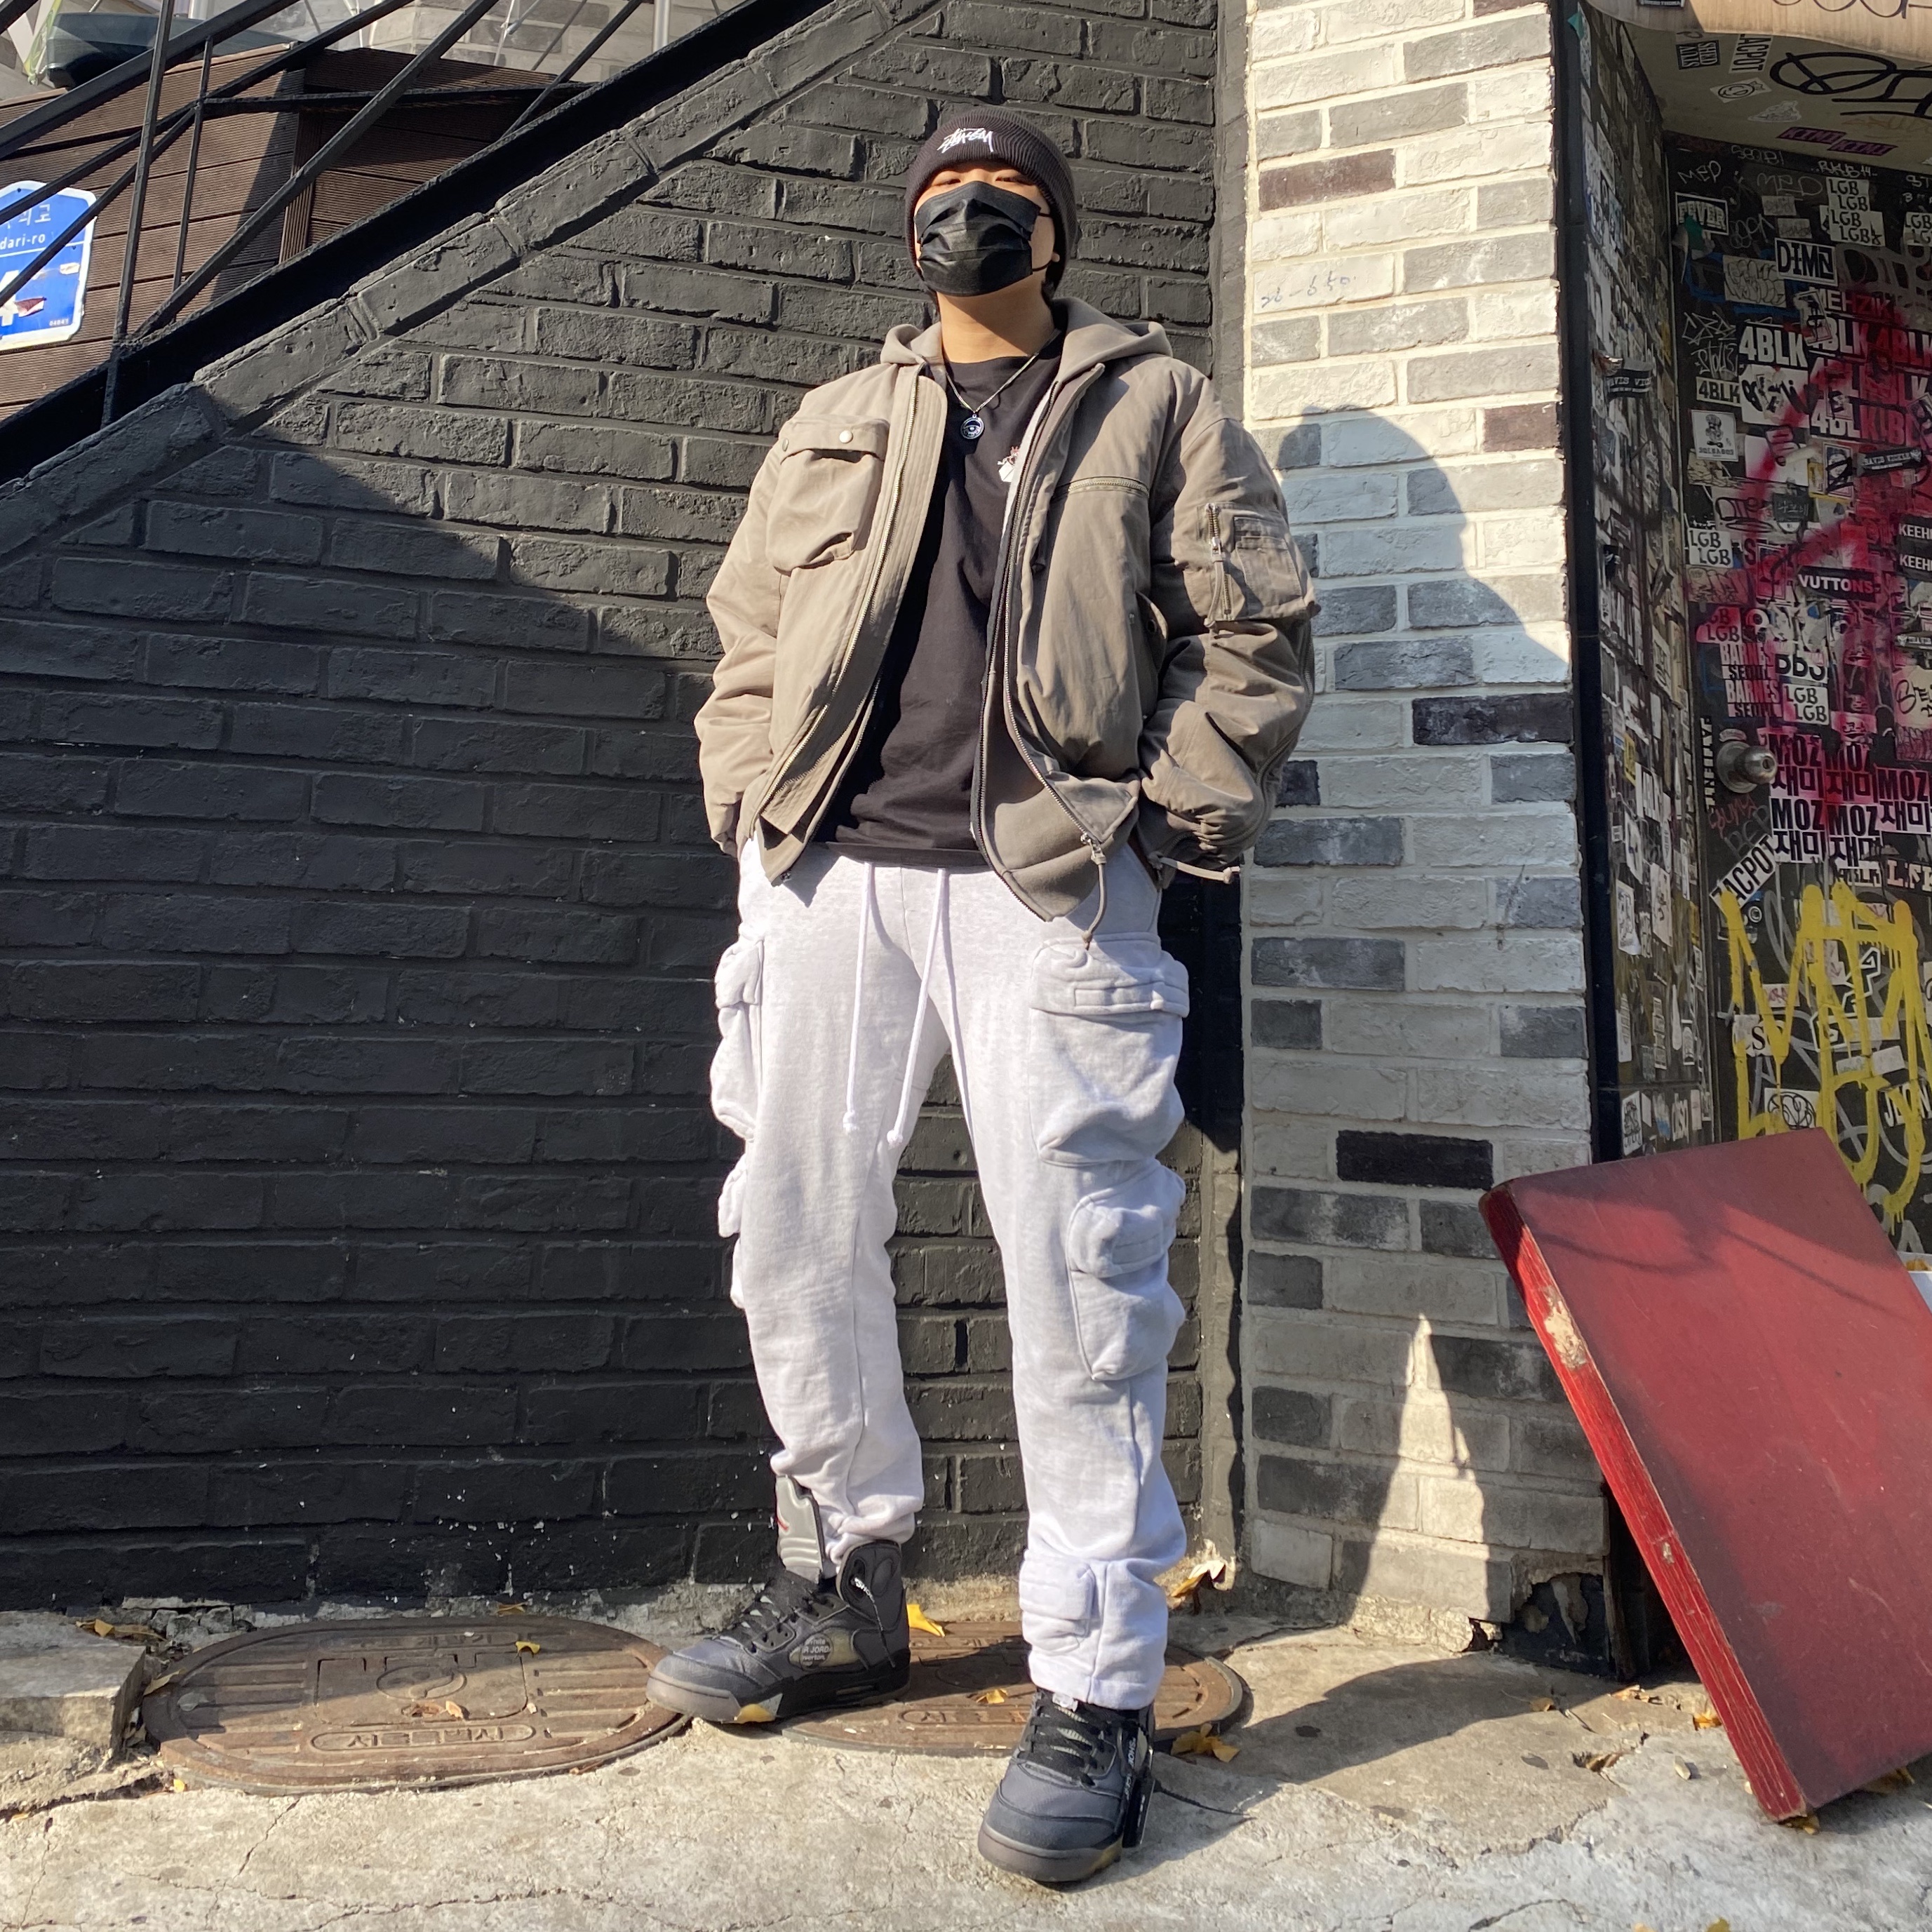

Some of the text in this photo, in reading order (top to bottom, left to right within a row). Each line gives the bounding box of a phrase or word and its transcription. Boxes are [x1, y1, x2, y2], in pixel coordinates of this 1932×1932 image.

[1731, 34, 1771, 72] ACPOT
[1828, 179, 1859, 196] LGB
[1837, 194, 1868, 212] LGB
[1830, 210, 1862, 228] LGB
[1911, 229, 1932, 244] LG
[1738, 326, 1808, 368] 4BLK
[1813, 316, 1870, 359] BLK
[1698, 380, 1740, 404] 4BLK
[1689, 530, 1721, 548] LGB
[1898, 523, 1932, 540] KEEH
[1698, 547, 1731, 565] LGB
[1899, 554, 1932, 572] KEEH
[1797, 573, 1874, 593] VUTTONS
[1706, 624, 1740, 642] LGB
[1725, 679, 1780, 704] BARNES
[1784, 685, 1818, 704] LGB
[1794, 702, 1827, 723] LGB
[1877, 769, 1929, 802] MOZ
[1771, 798, 1825, 831] MOZ
[1827, 804, 1881, 836] MOZ
